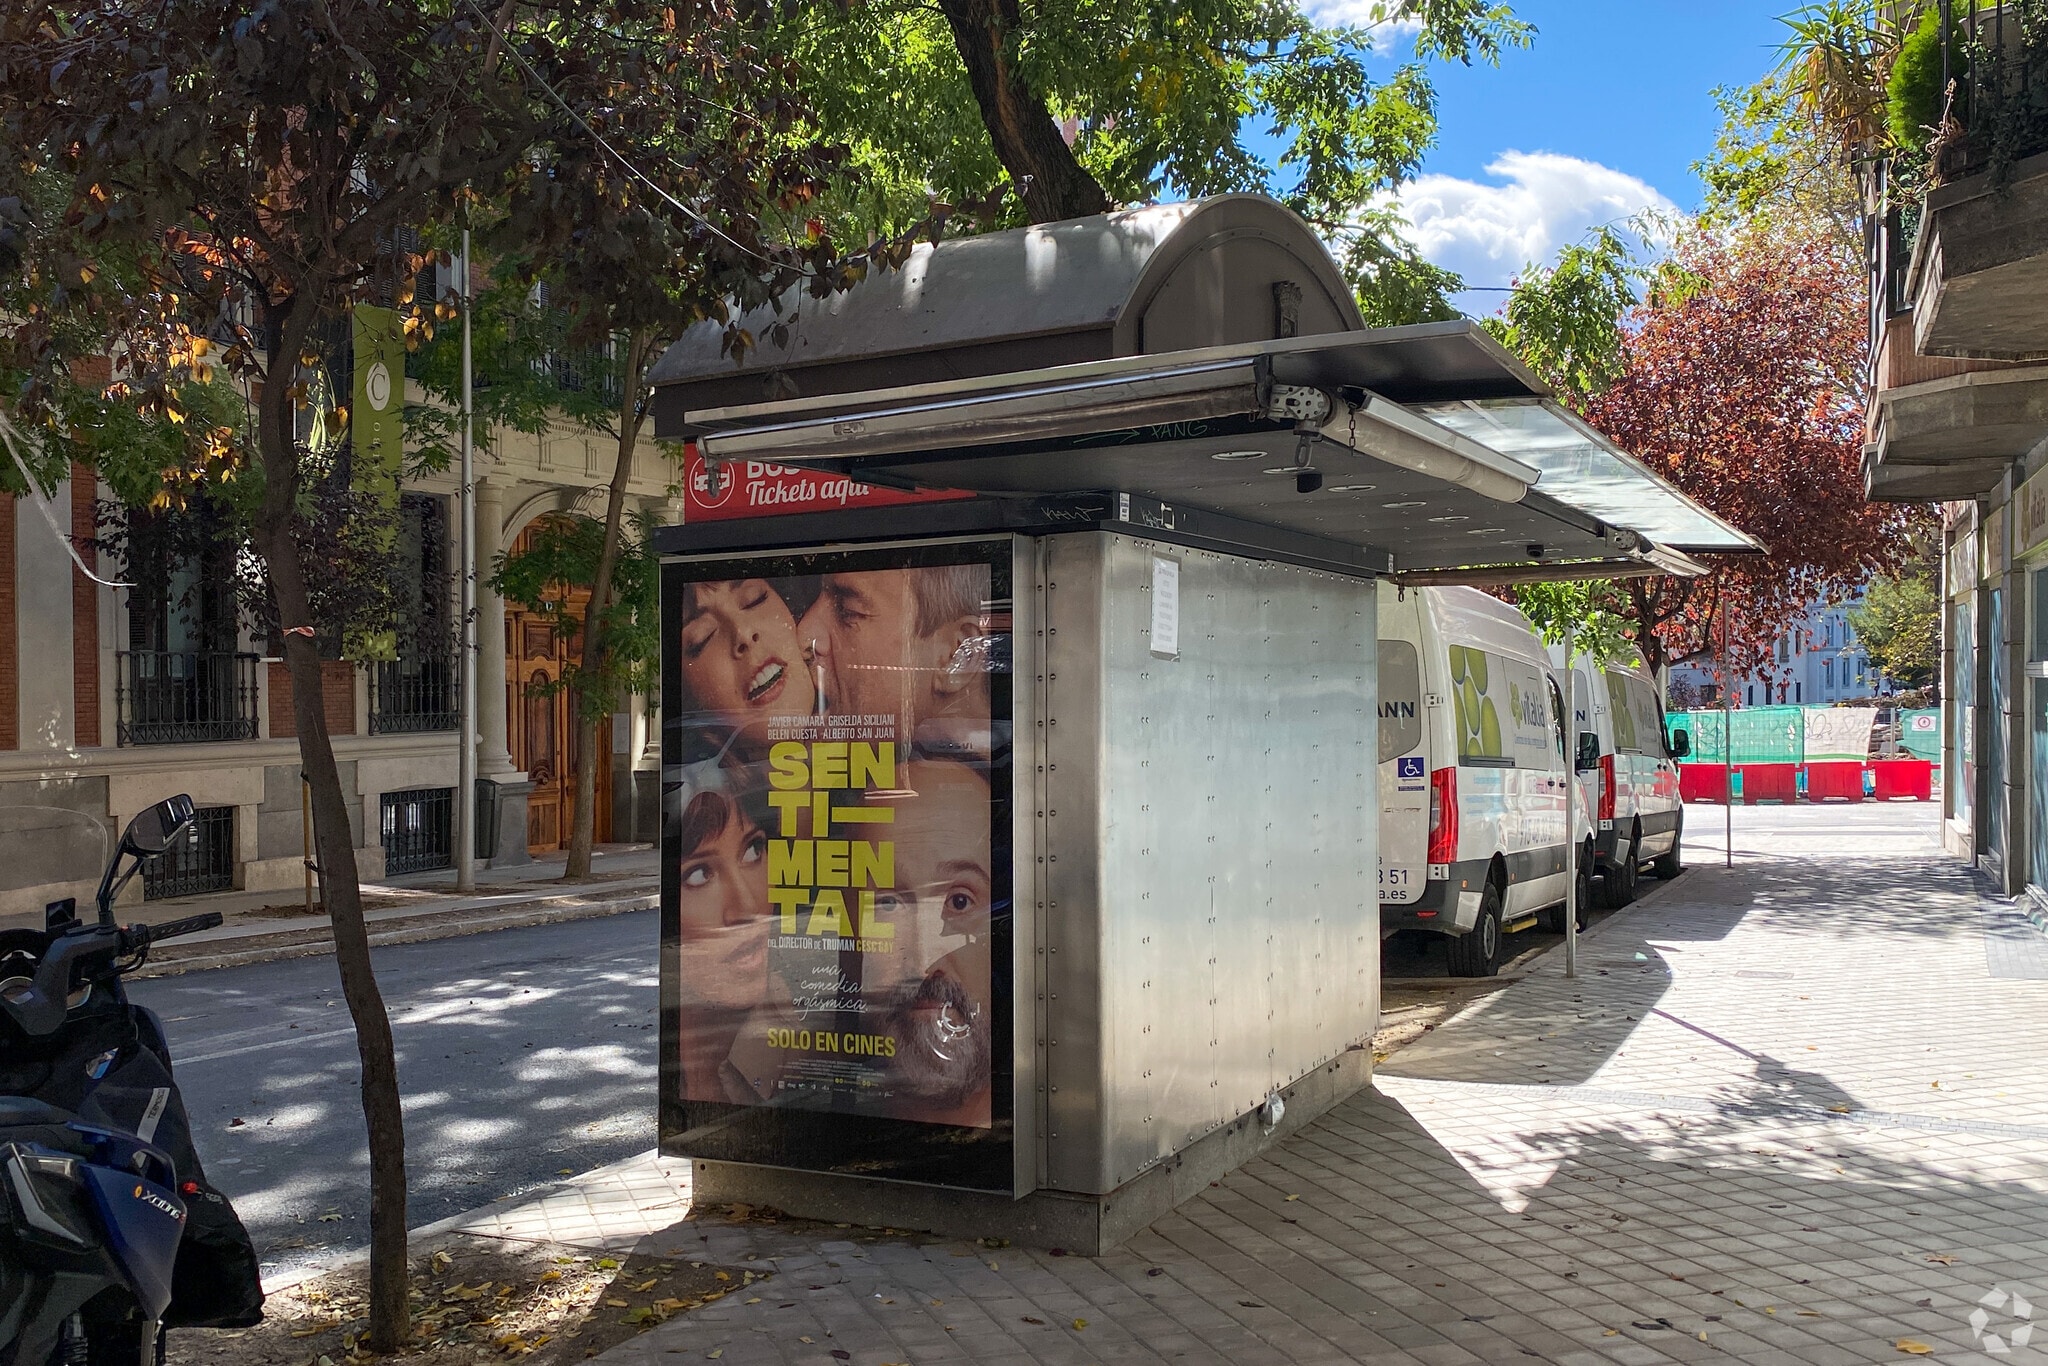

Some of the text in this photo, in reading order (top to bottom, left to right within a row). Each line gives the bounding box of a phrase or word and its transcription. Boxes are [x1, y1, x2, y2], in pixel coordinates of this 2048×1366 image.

[746, 479, 816, 506] Tickets
[768, 716, 791, 727] JAVIER
[828, 715, 862, 727] GRISELDA
[864, 714, 895, 726] SICILIANI
[791, 728, 818, 740] CUESTA
[823, 727, 856, 740] ALBERTO
[857, 727, 872, 739] SAN
[875, 727, 895, 739] JUAN
[768, 741, 896, 790] SEN
[767, 839, 895, 888] MEN
[1389, 869, 1408, 885] 51
[767, 888, 895, 938] TAL
[779, 936, 813, 950] DIRECTOR
[822, 938, 855, 952] TRUMAN
[812, 964, 843, 976] una
[800, 973, 864, 993] comedia
[767, 1028, 896, 1057] SOLO EN CINES
